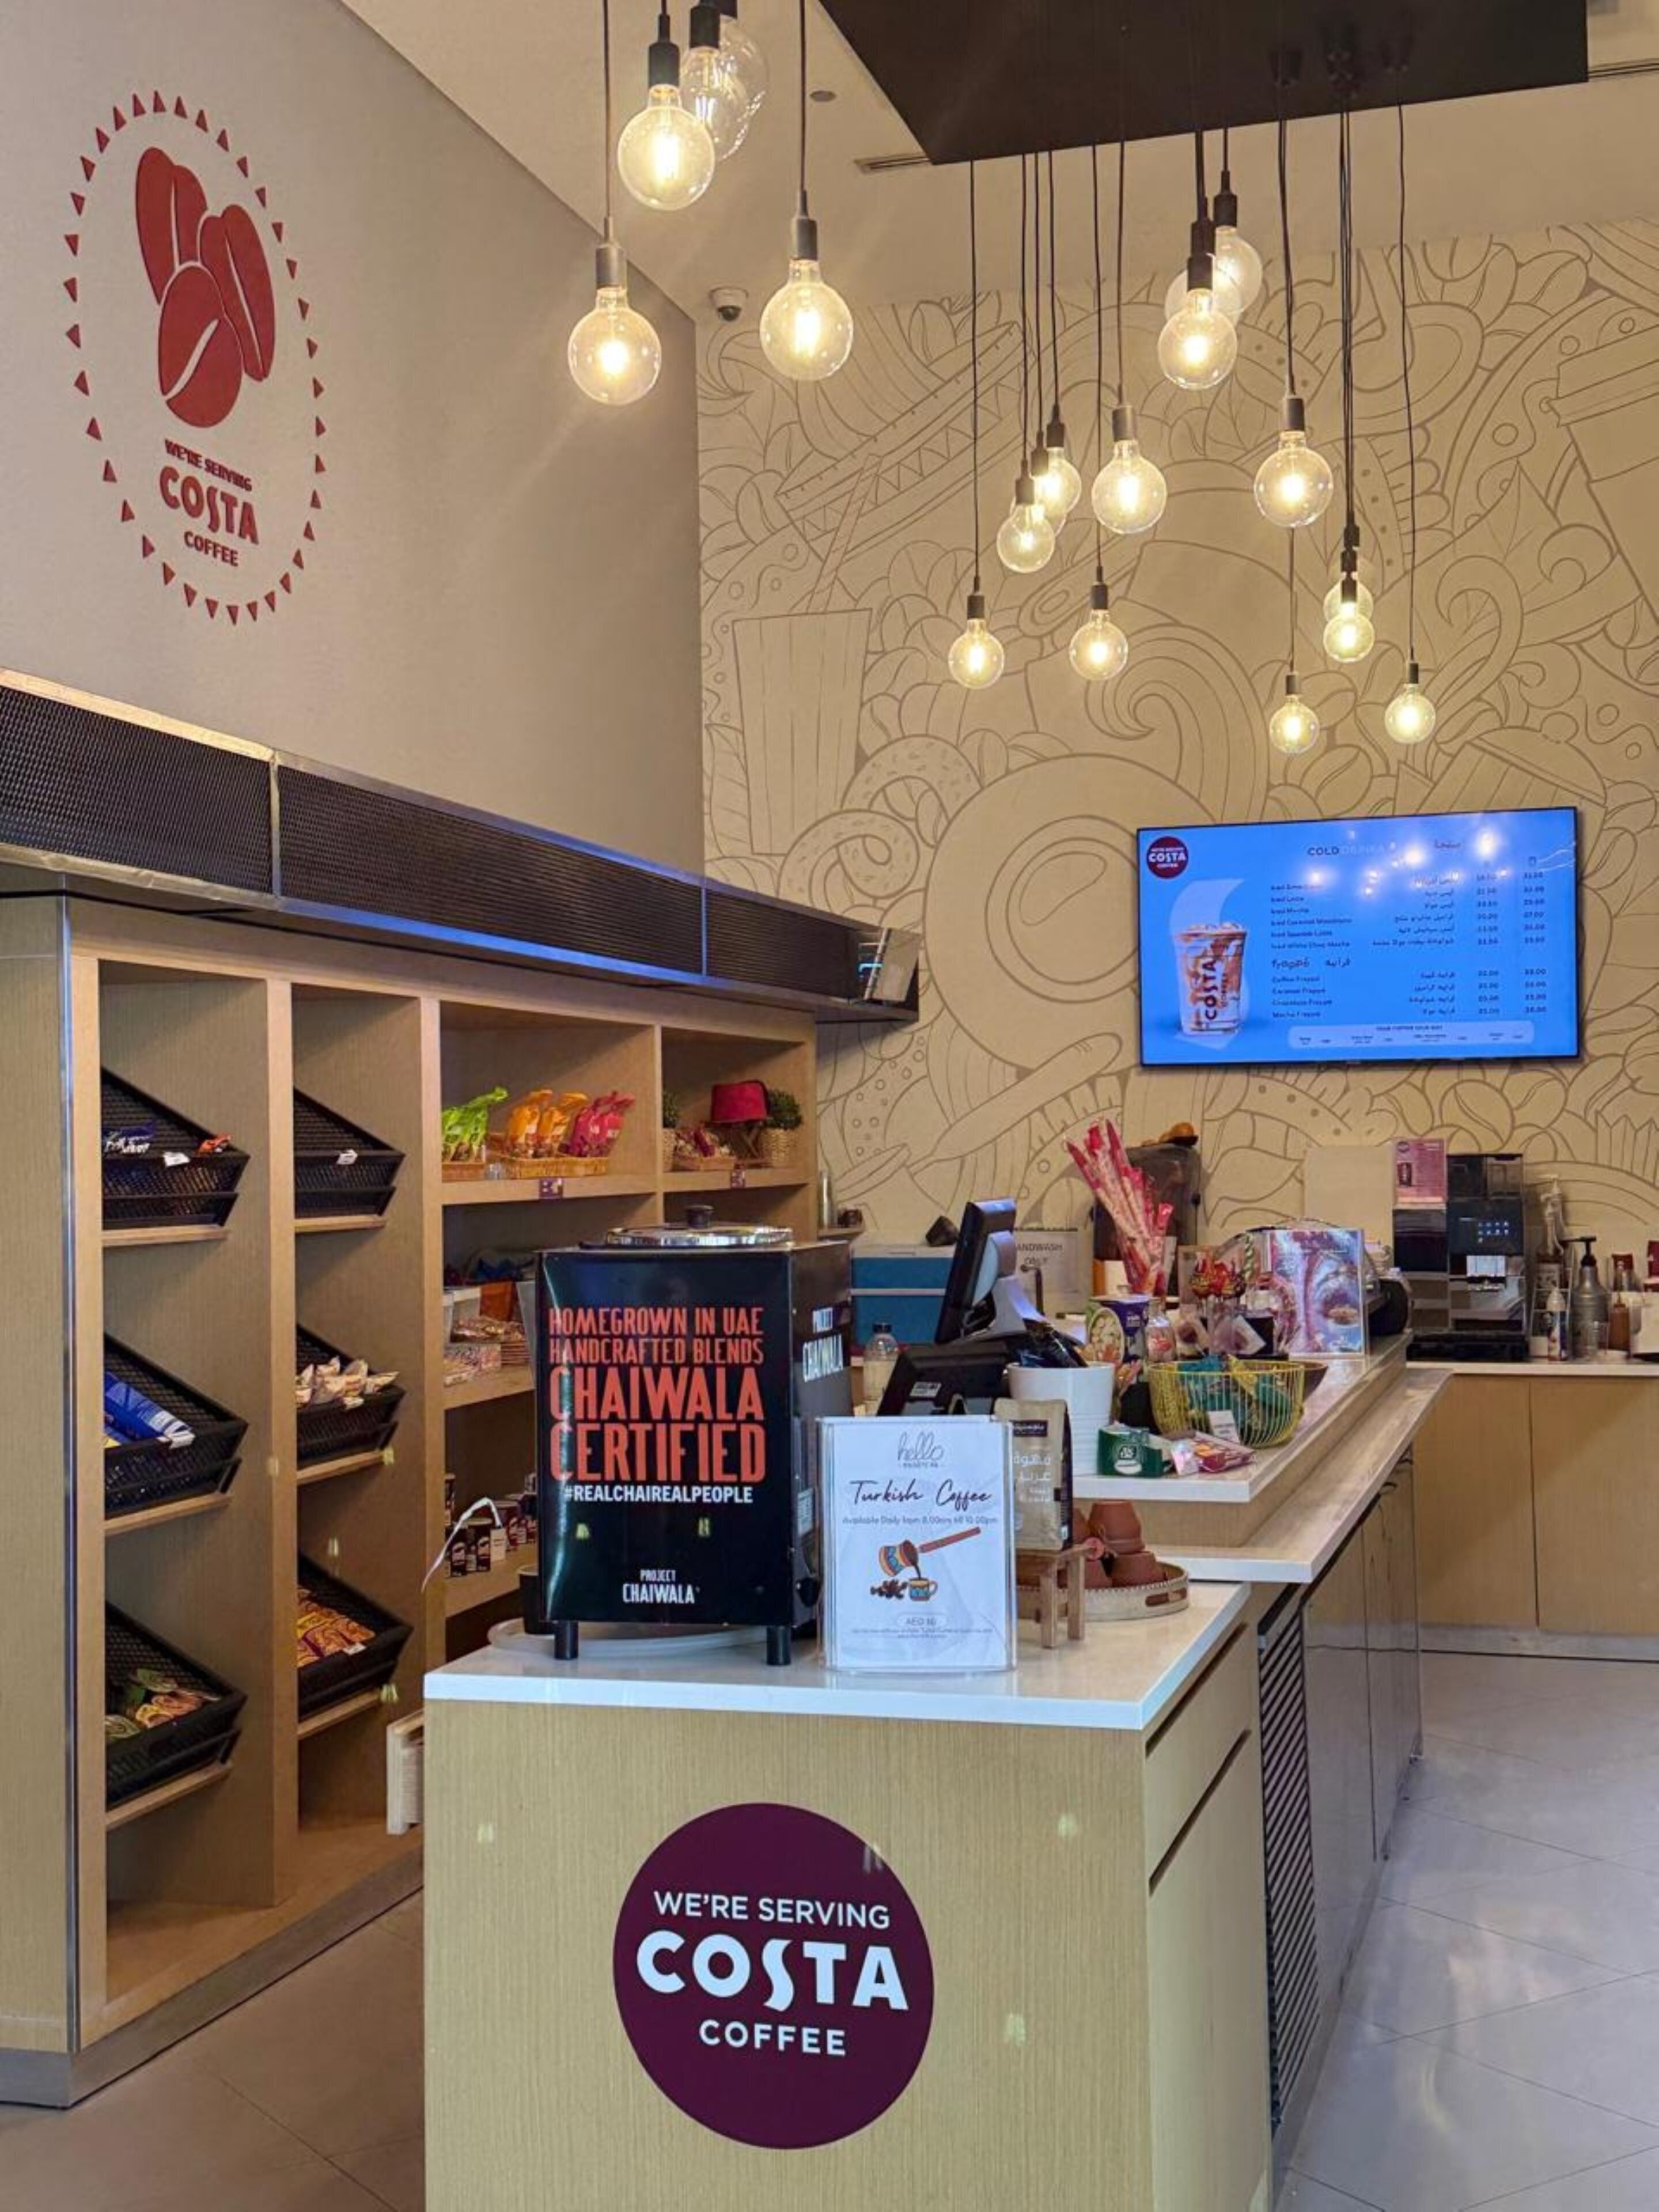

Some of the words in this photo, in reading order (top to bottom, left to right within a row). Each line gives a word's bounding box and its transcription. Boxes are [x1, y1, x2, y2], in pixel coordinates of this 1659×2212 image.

[204, 459, 252, 492] SERVING
[159, 465, 259, 546] COSTA
[184, 531, 238, 567] COFFEE
[1148, 852, 1187, 863] COSTA
[1307, 847, 1339, 856] COLD
[1202, 959, 1218, 1021] COSTA
[548, 1308, 686, 1336] HOMEGROWN
[695, 1308, 717, 1335] IN
[723, 1307, 764, 1335] UAE
[548, 1338, 686, 1365] HANDCRAFTED
[693, 1338, 764, 1364] BLENDS
[549, 1366, 764, 1421] CHAIWALA
[549, 1423, 766, 1484] CERTIFIED
[897, 1431, 945, 1461] hello
[564, 1484, 753, 1504] #REALCHAIREALPEOPLE
[850, 1478, 924, 1506] Turkish
[935, 1478, 992, 1512] Coffee
[640, 1569, 676, 1582] PROJECT
[622, 1583, 695, 1604] CHAIWALA
[758, 1898, 890, 1929] SERVING
[637, 1929, 909, 2012] COSTA
[699, 2019, 846, 2056] COFFEE
